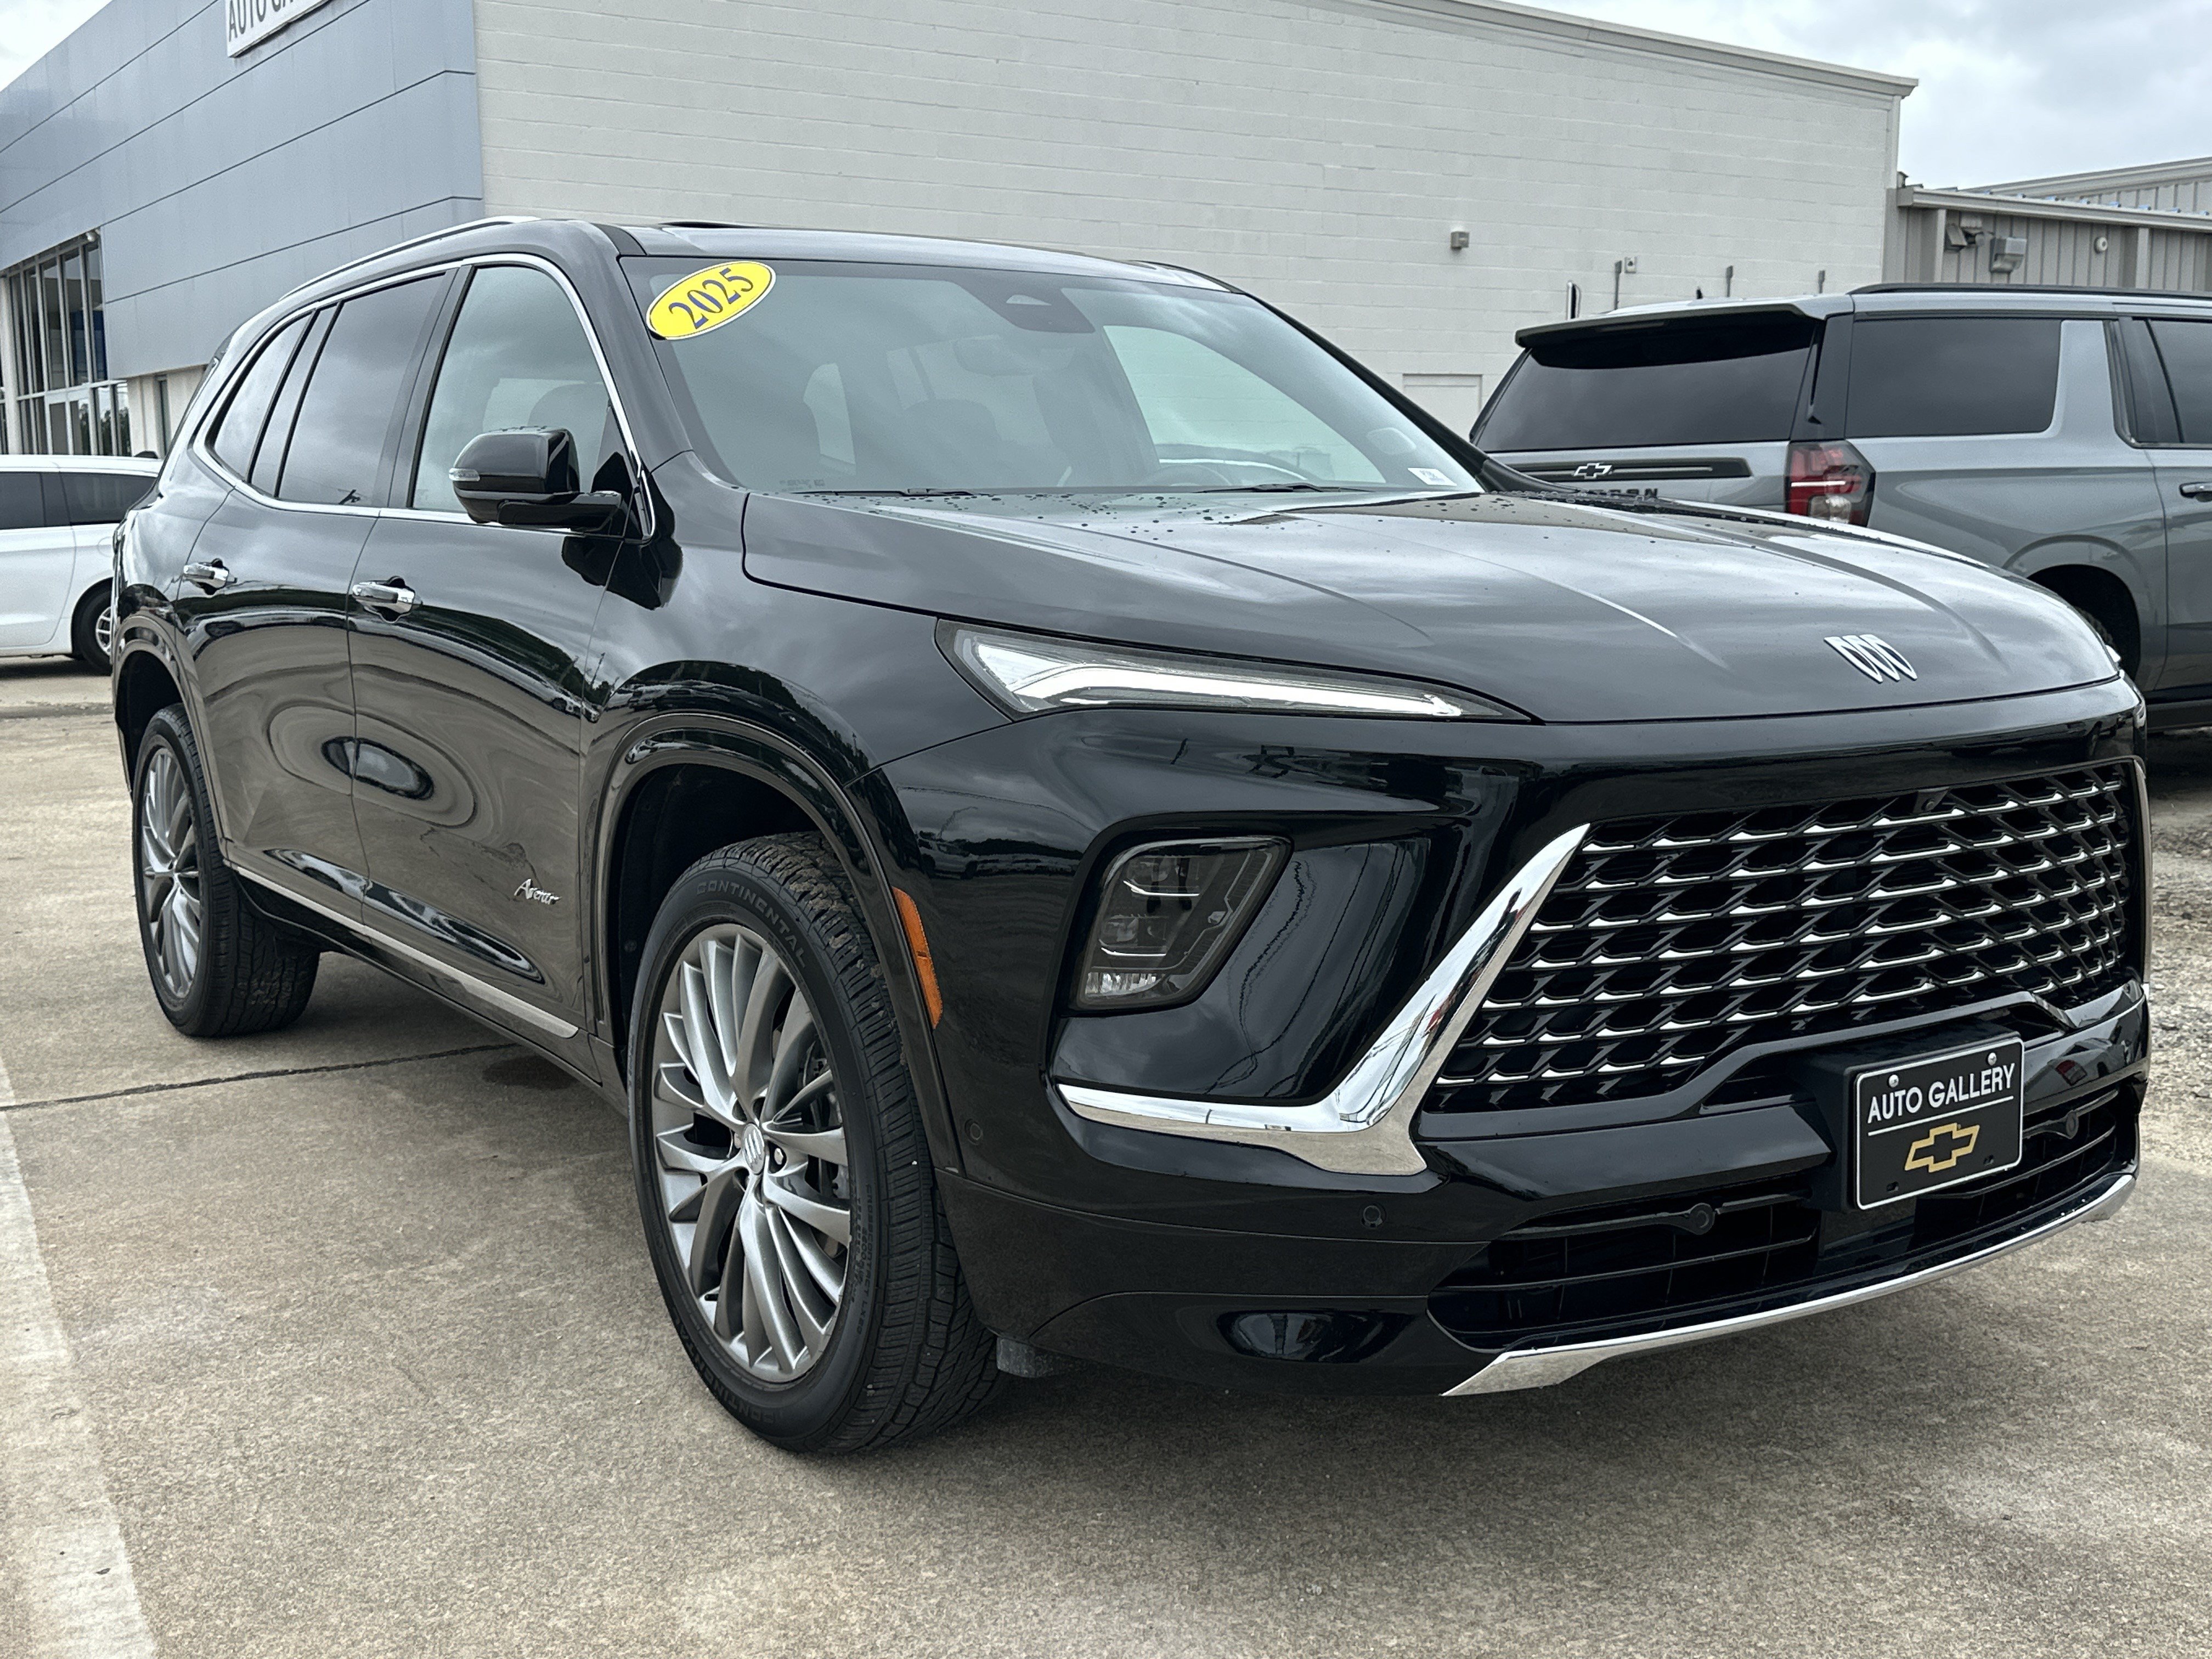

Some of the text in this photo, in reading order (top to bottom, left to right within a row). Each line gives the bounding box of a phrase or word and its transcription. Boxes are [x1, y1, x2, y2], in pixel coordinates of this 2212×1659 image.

[229, 0, 266, 42] AUTO
[669, 267, 753, 329] 2025
[697, 880, 805, 968] CONTINENTAL
[1867, 1063, 2015, 1124] AUTO GALLERY
